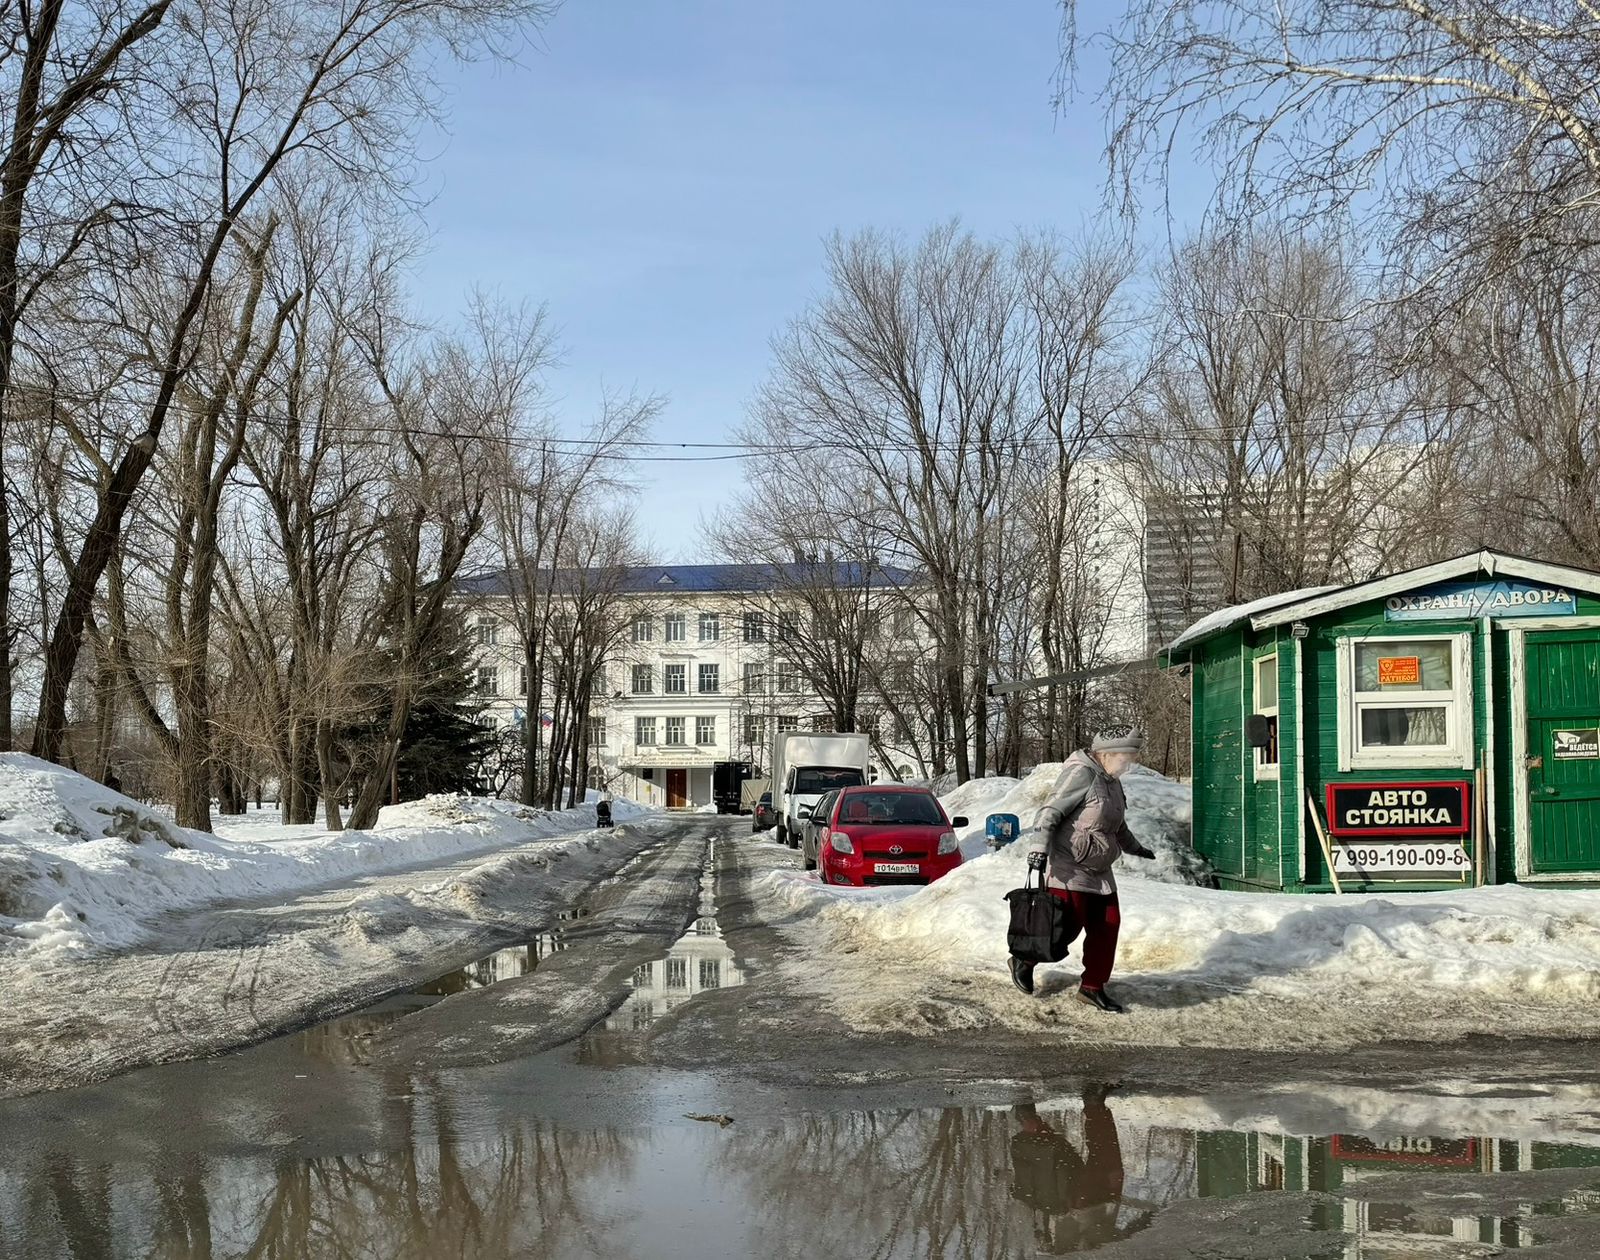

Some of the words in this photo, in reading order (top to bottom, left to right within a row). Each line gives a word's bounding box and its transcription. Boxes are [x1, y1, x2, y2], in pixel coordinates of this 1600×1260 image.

[1386, 593, 1482, 611] ОХРАНА
[1491, 589, 1571, 609] ДВОРА
[1368, 790, 1427, 806] АВТО
[1345, 808, 1452, 825] СТОЯНКА
[1347, 848, 1469, 866] 999-190-09-8
